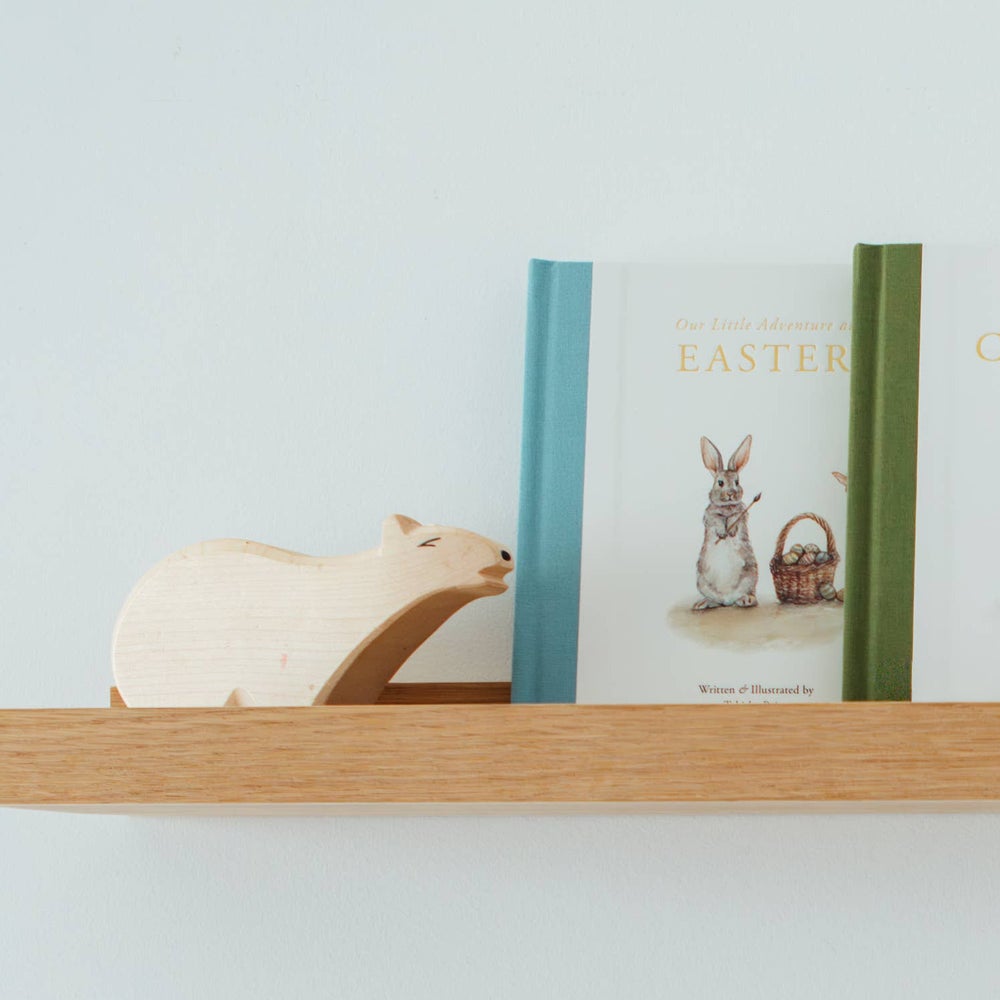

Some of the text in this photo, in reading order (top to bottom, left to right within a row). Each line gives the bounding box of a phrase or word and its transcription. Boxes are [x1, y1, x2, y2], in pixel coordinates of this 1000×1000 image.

[675, 317, 852, 331] Our Little Adventure a
[676, 343, 850, 373] EASTER
[698, 684, 815, 697] Written & Illustrated by
